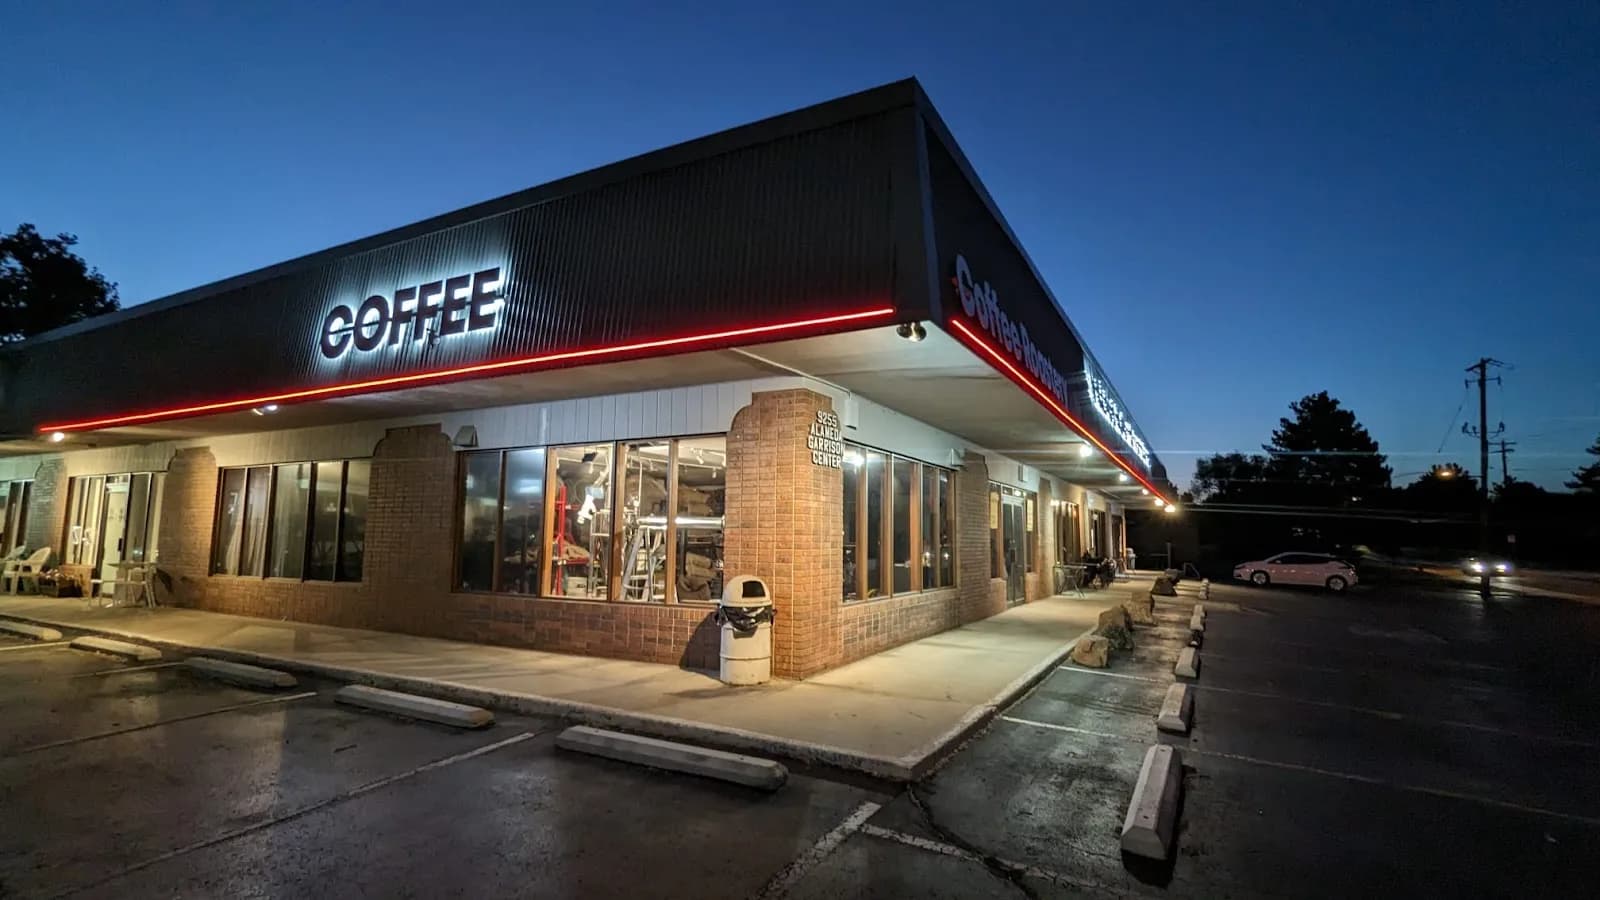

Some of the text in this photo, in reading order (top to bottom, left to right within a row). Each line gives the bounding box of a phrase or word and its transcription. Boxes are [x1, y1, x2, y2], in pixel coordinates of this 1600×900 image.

[320, 267, 500, 358] COFFEE
[956, 254, 1022, 361] Coffee
[817, 410, 837, 427] 9255
[810, 422, 842, 441] ALAMEDA
[808, 435, 845, 456] GARRISON
[812, 450, 841, 468] CENTER
